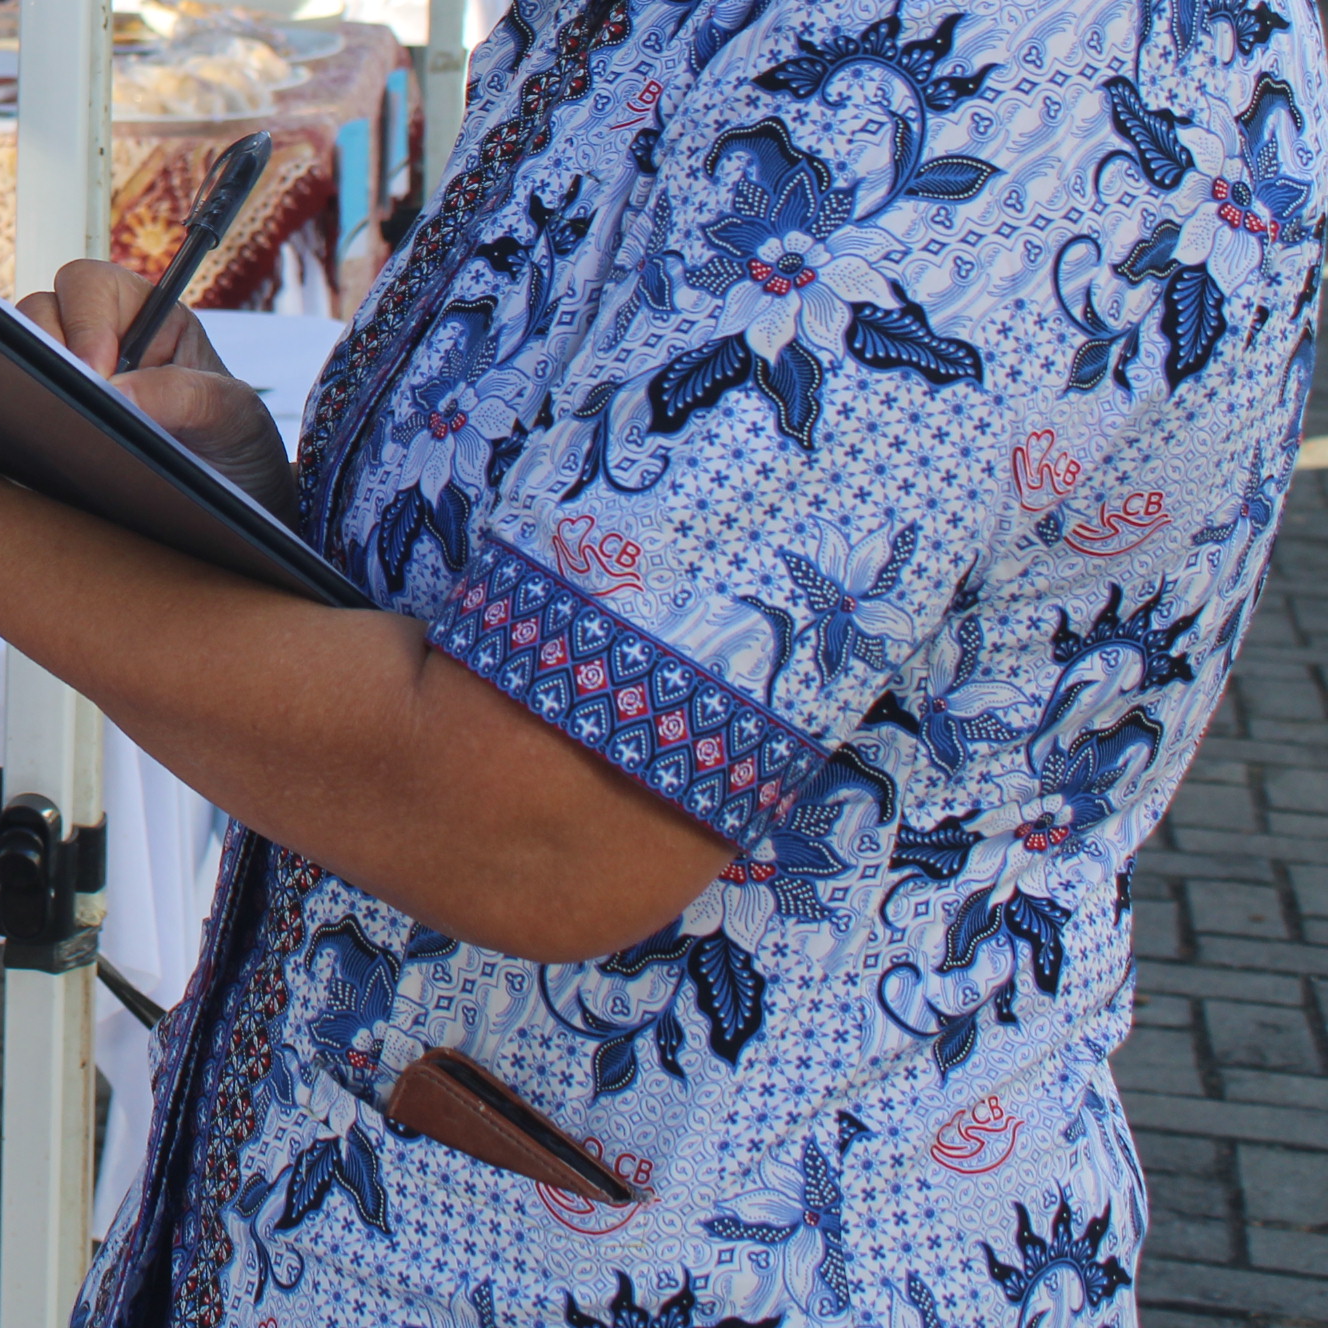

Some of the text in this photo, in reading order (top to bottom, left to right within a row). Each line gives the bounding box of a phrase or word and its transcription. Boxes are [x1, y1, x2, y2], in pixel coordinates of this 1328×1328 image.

[1054, 451, 1081, 486] CB
[1122, 492, 1163, 516] CB
[598, 532, 641, 568] CB
[971, 1096, 1004, 1124] CB
[614, 1153, 653, 1184] CB
